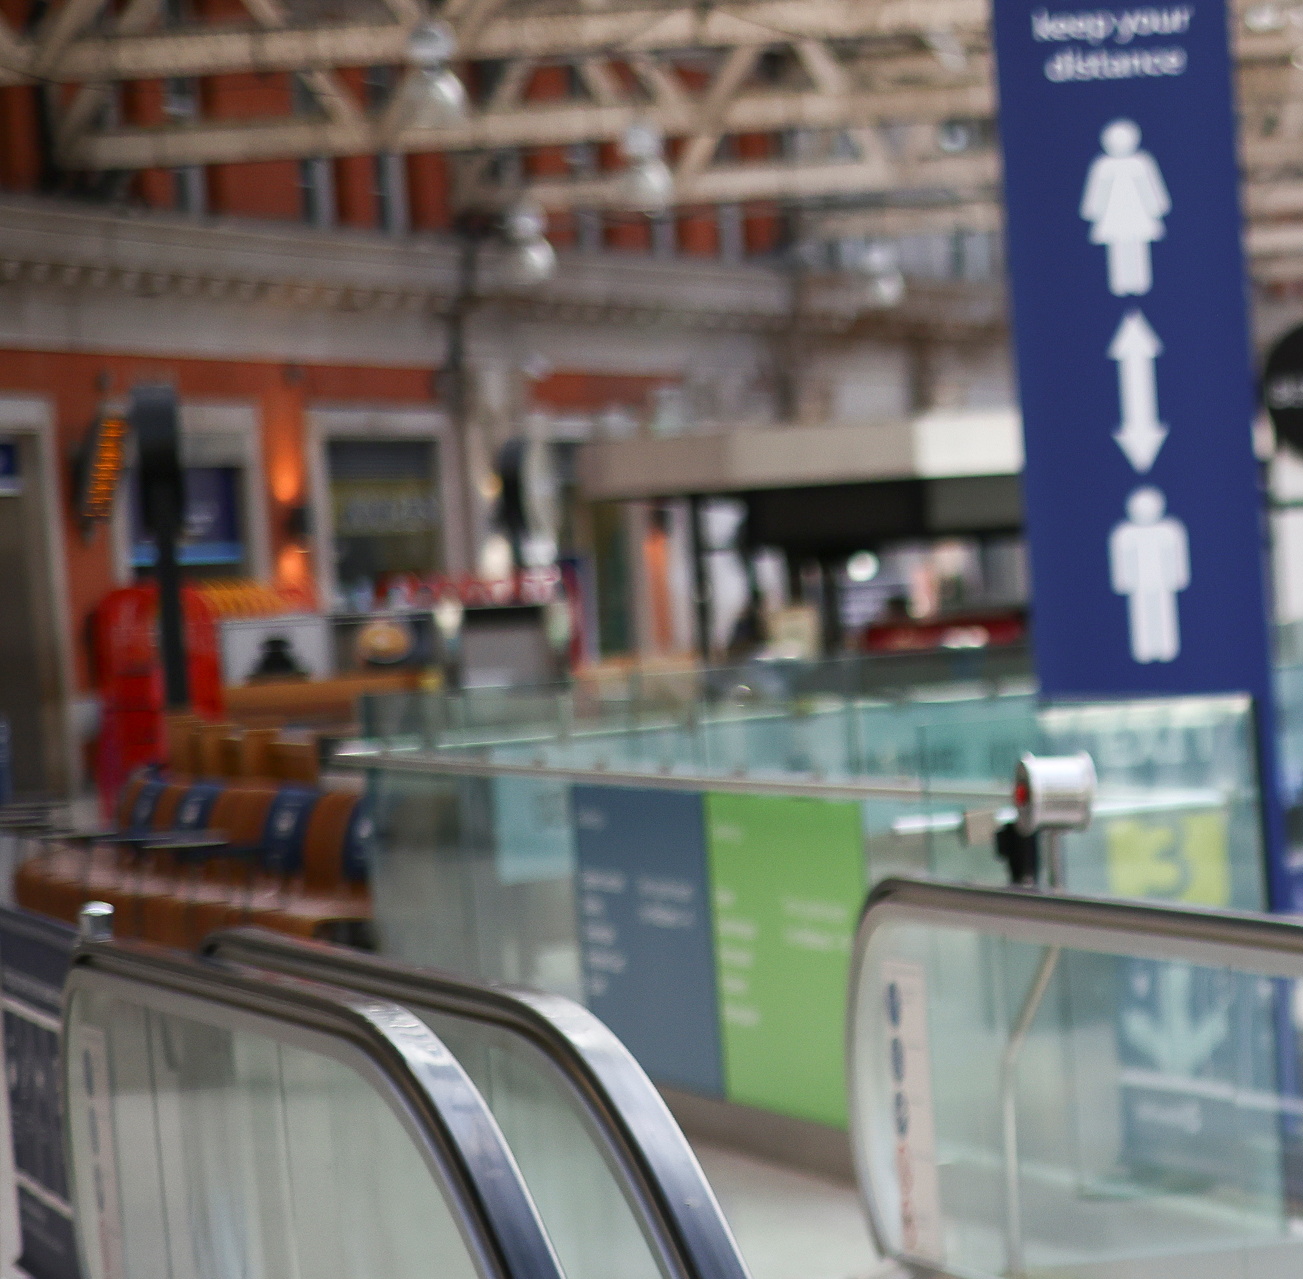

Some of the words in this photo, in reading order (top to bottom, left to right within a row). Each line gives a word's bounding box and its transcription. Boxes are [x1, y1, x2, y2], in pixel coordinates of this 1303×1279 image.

[1031, 7, 1114, 45] keep
[1114, 5, 1194, 44] your
[1044, 48, 1187, 83] distance
